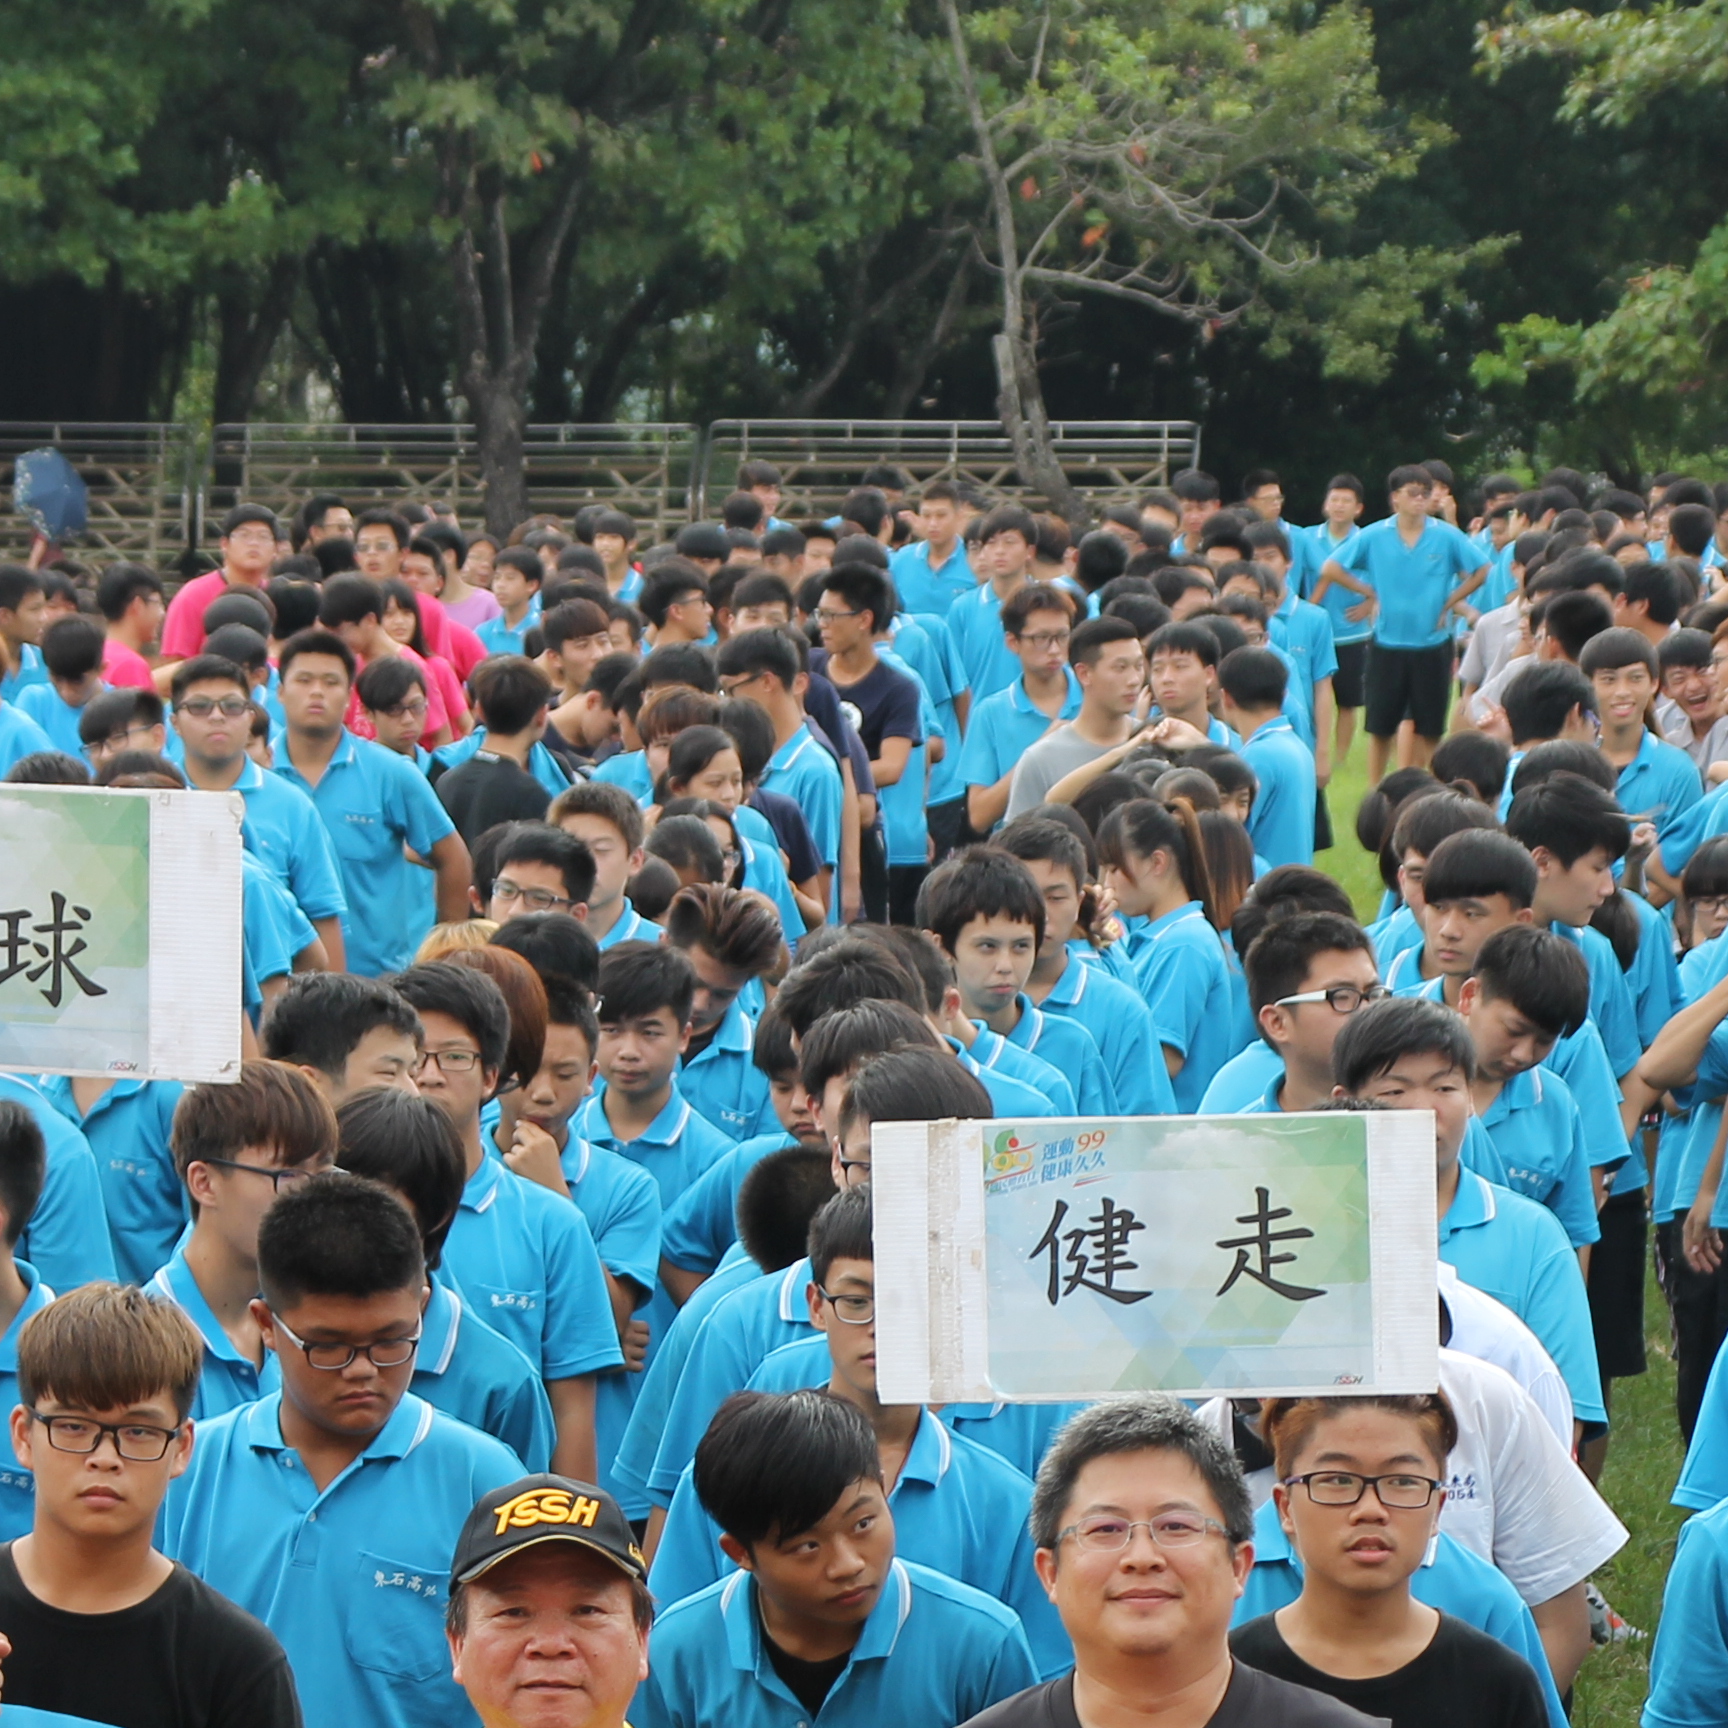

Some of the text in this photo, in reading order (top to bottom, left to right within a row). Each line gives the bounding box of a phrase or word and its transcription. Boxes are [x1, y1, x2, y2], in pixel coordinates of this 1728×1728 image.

[1041, 1149, 1106, 1184] 健康久久
[494, 1487, 600, 1536] TSSH
